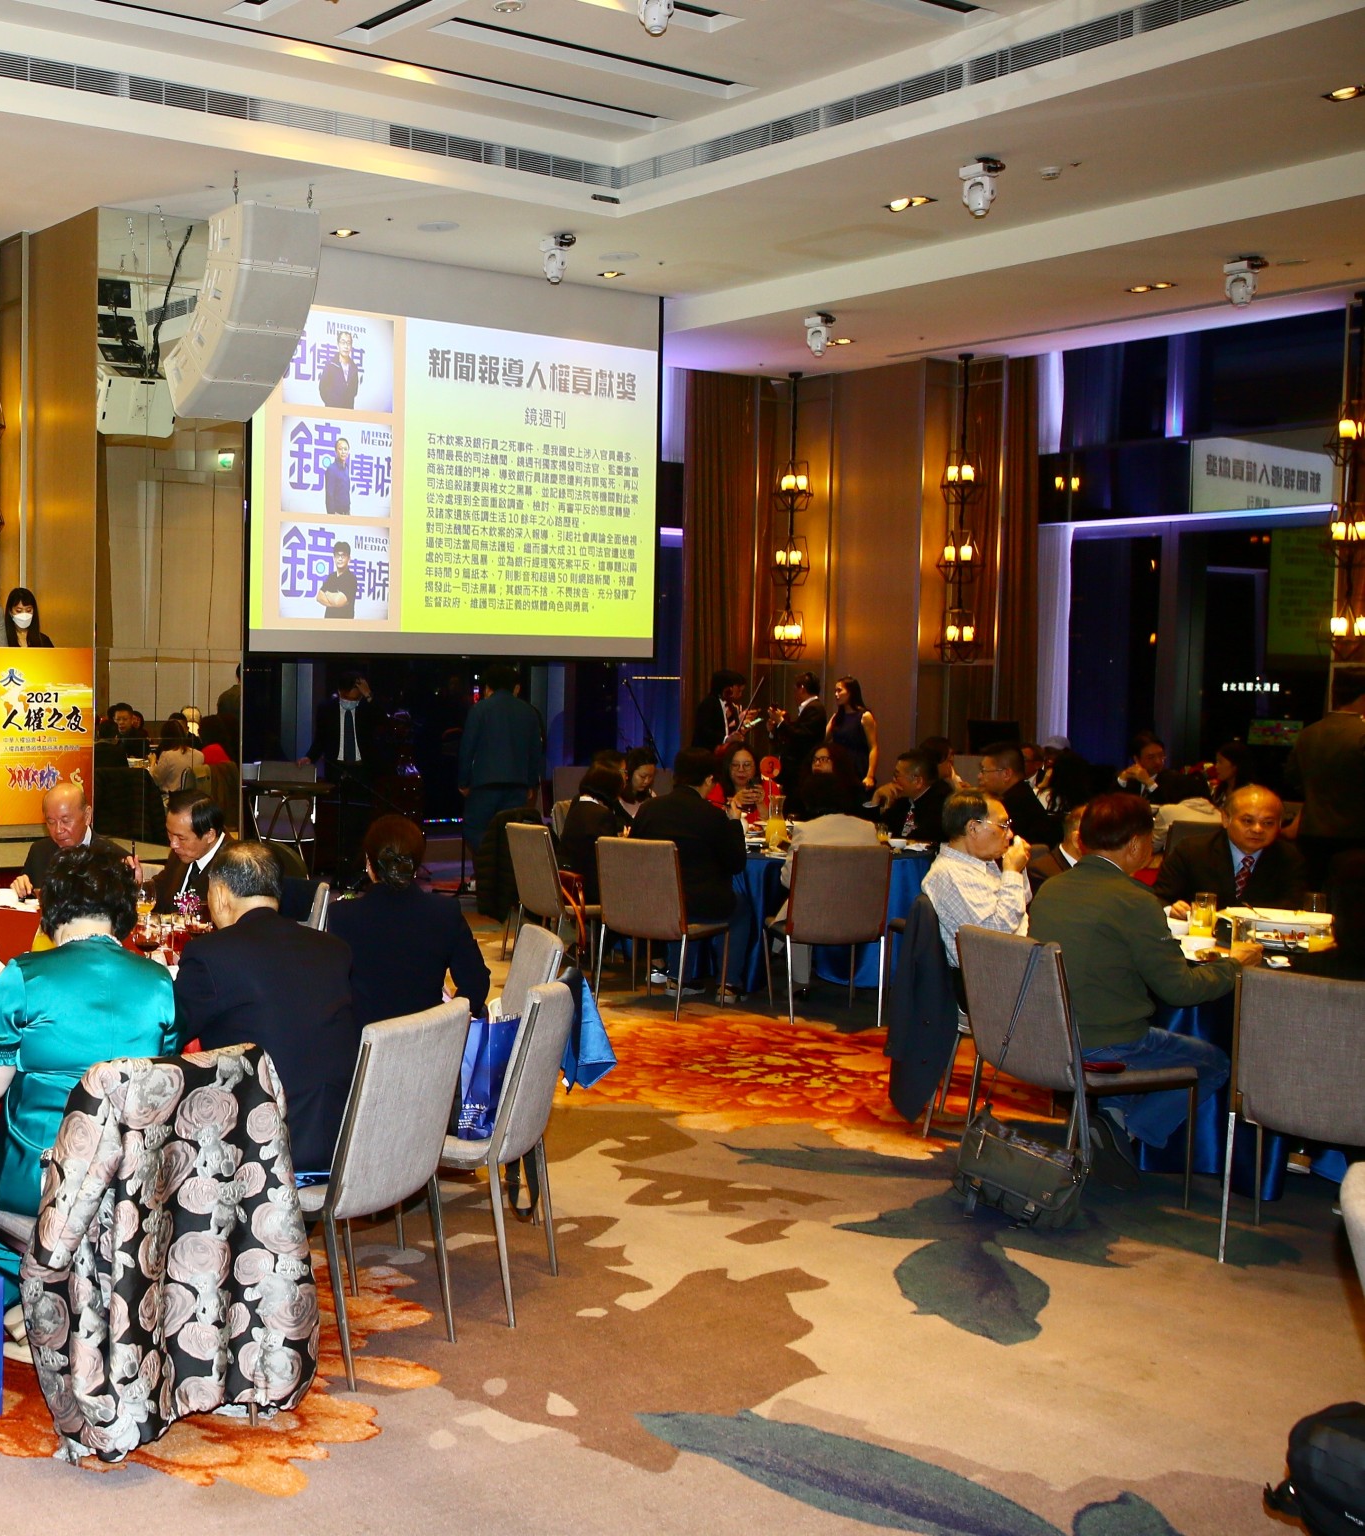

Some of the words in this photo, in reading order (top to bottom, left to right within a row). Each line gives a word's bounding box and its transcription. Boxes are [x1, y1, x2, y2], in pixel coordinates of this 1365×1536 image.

[428, 347, 637, 402] 新聞報導人權貢獻獎
[524, 406, 567, 430] 鏡週刊
[26, 692, 59, 704] 2021
[2, 706, 86, 733] 人權之夜
